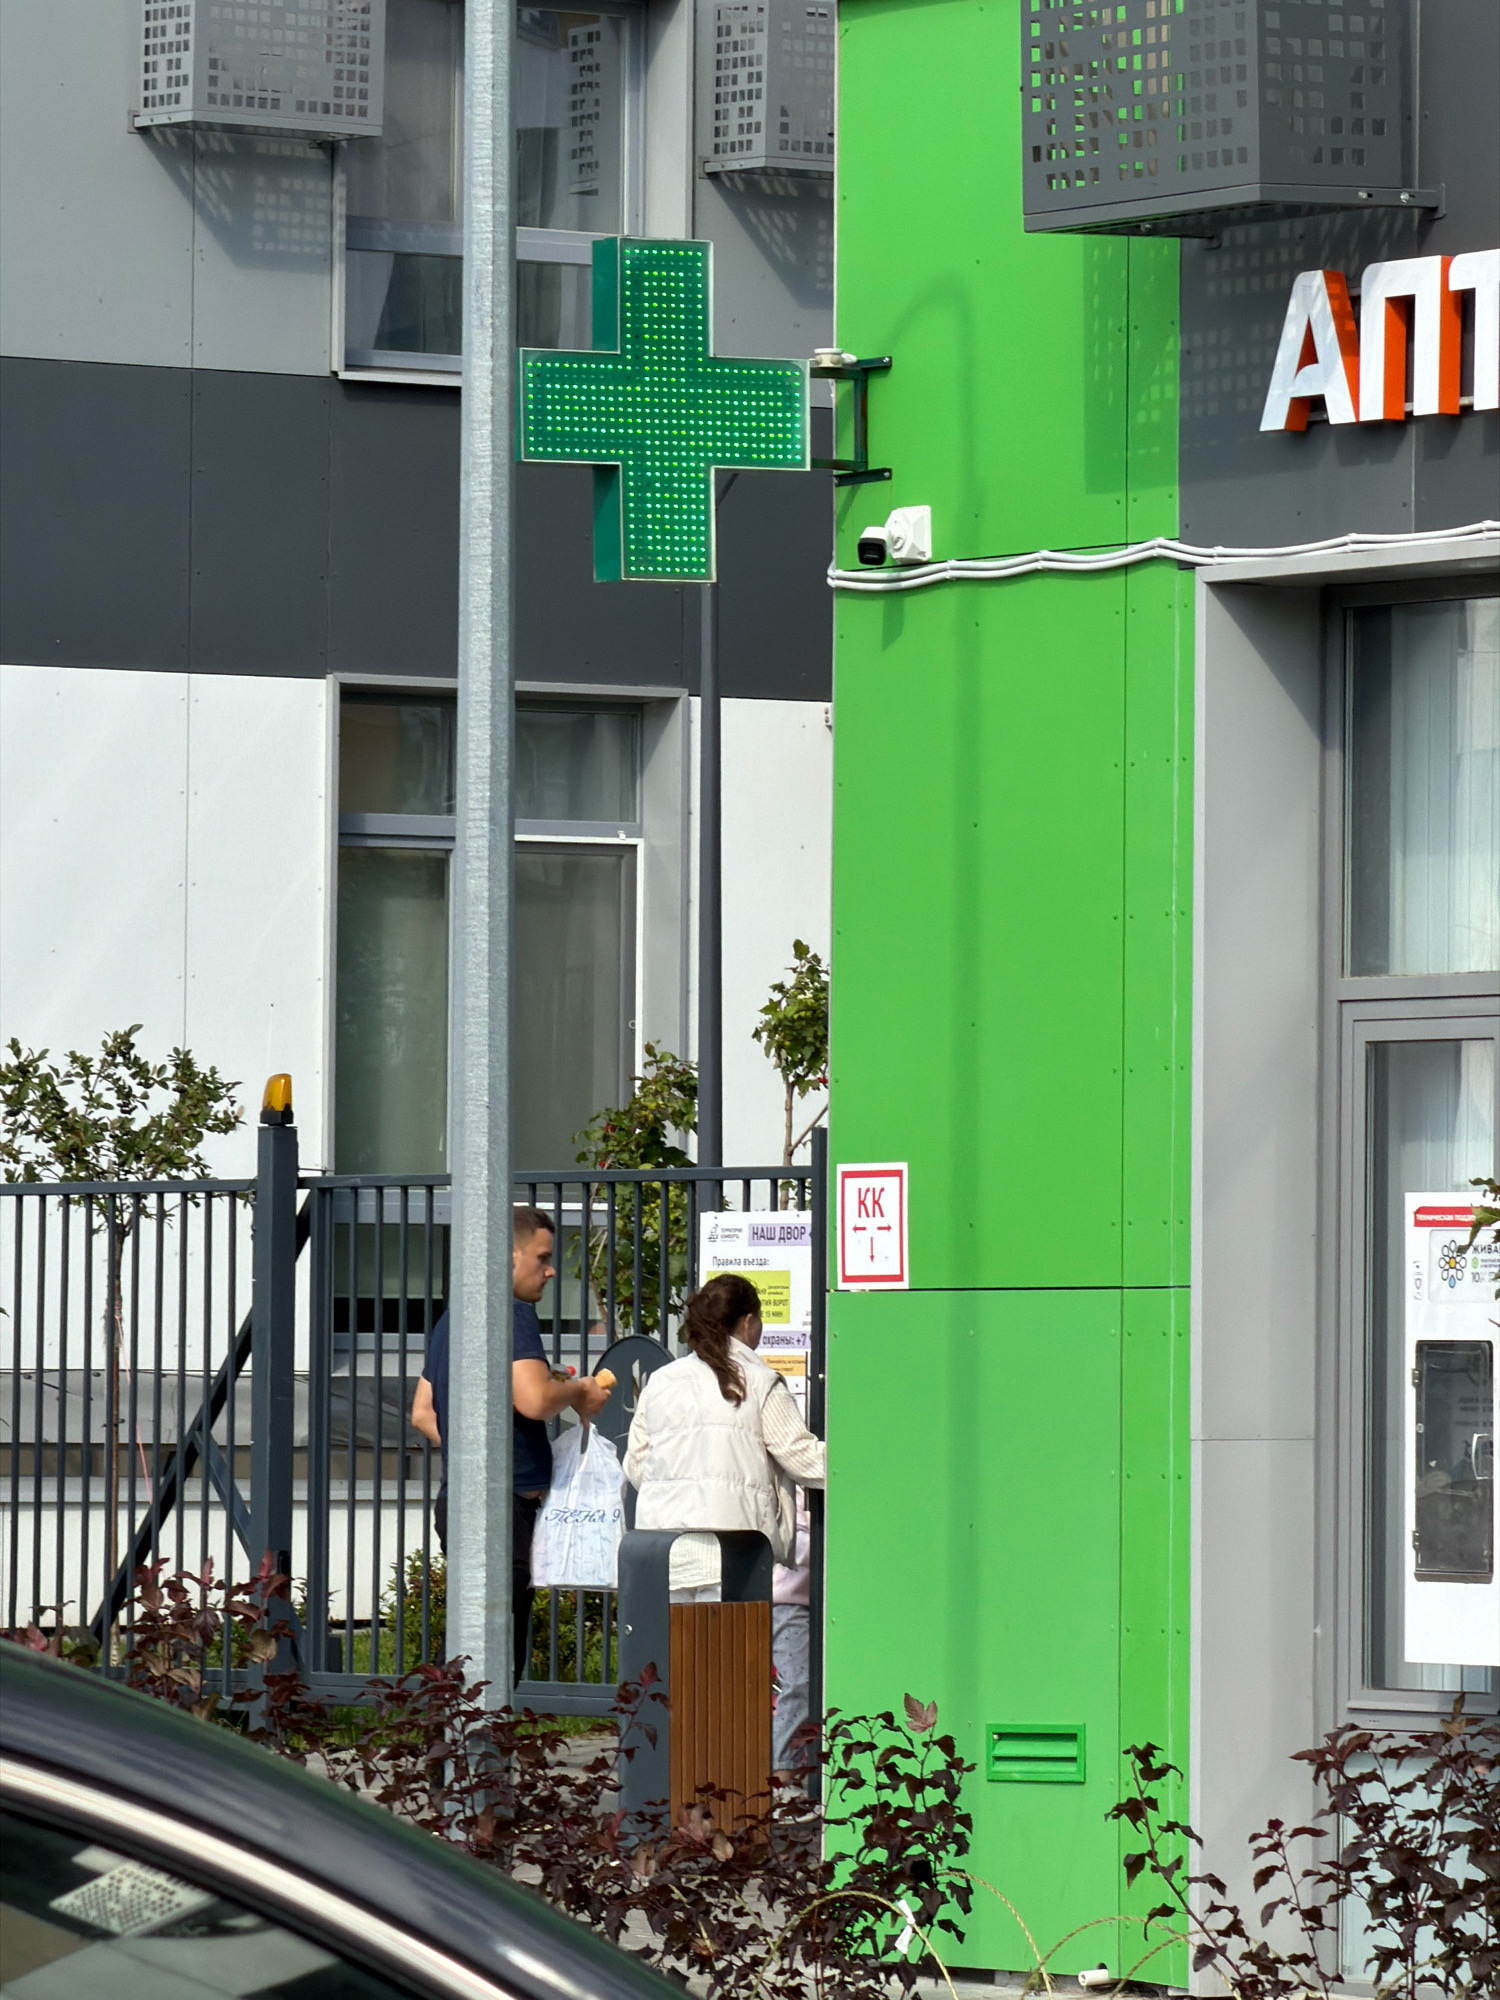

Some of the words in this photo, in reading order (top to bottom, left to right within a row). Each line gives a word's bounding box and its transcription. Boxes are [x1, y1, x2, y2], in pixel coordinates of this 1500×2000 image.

[858, 1187, 885, 1218] КК
[752, 1226, 776, 1241] НАШ
[778, 1226, 807, 1243] ДВОР
[1471, 1244, 1500, 1255] ЖИВА
[712, 1256, 741, 1268] Правила
[743, 1258, 770, 1267] въезда:
